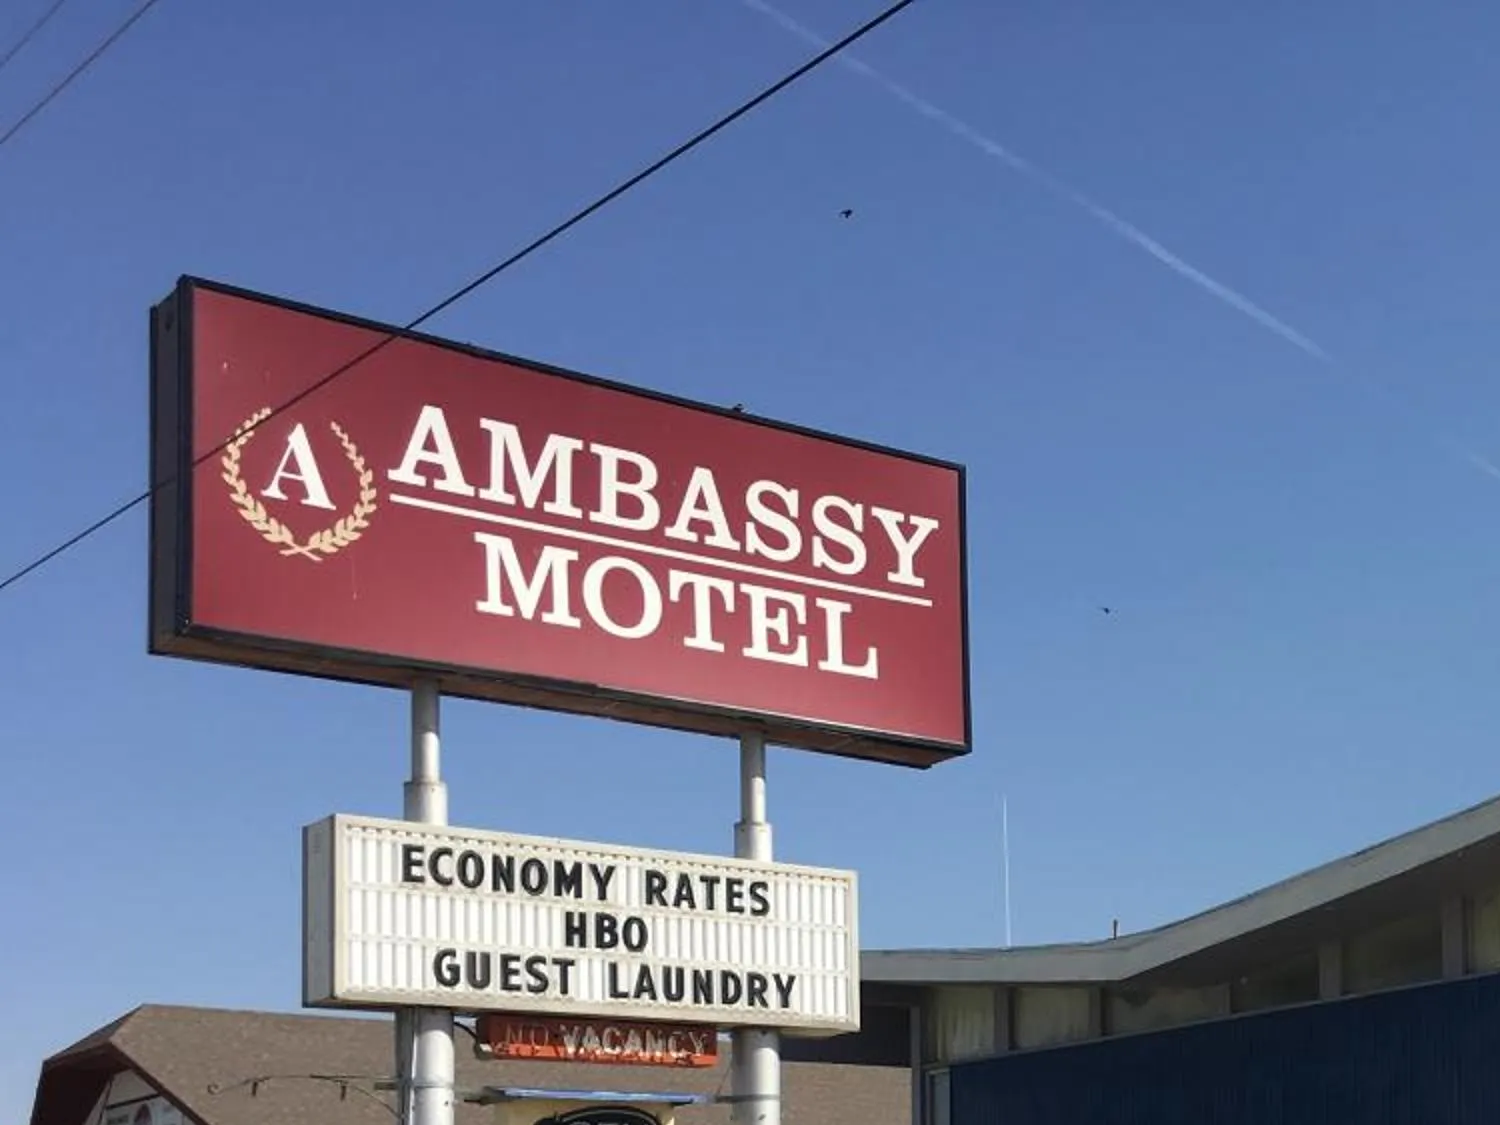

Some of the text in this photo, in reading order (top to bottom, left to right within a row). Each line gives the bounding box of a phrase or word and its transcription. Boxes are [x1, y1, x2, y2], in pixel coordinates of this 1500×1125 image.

[260, 423, 337, 511] A
[387, 404, 939, 588] AMBASSY
[474, 531, 879, 680] MOTEL
[402, 844, 770, 916] ECONOMY RATES
[565, 911, 648, 952] HBO
[433, 948, 796, 1009] GUEST LAUNDRY
[560, 1024, 709, 1058] VACANCY
